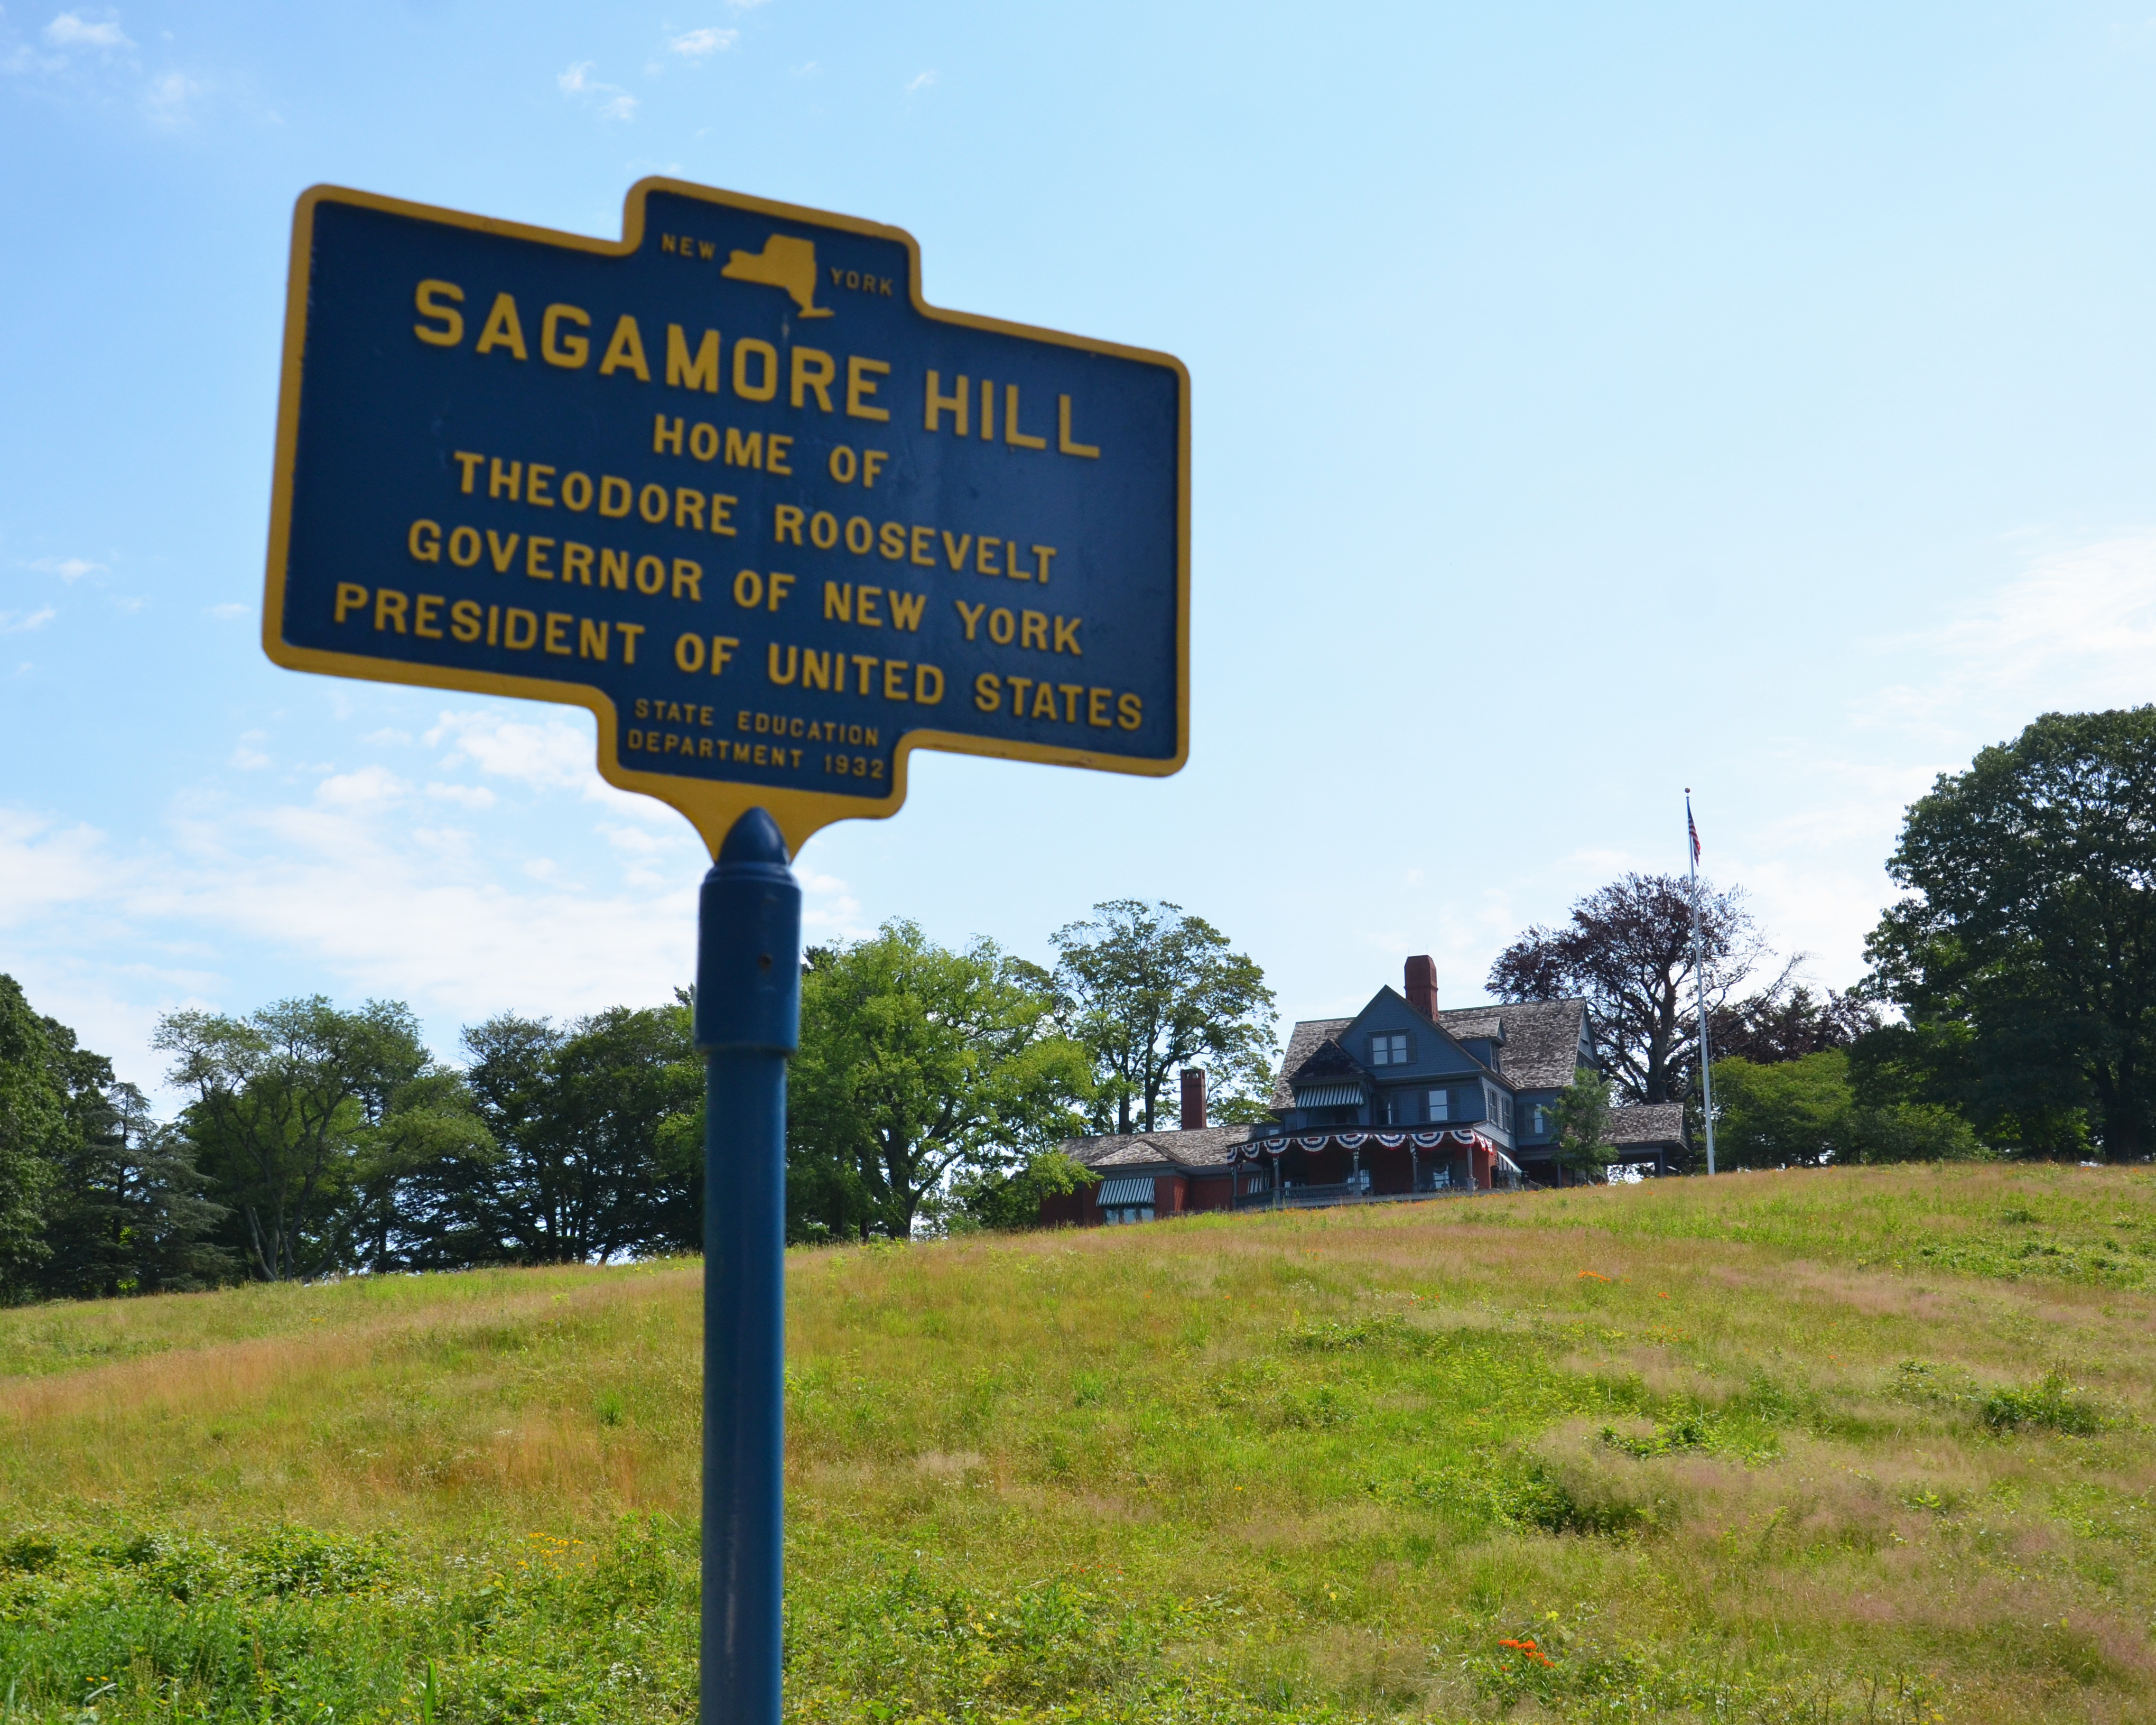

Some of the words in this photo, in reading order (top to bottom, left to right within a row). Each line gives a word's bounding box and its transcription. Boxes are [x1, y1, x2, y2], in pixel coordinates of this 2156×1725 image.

[661, 234, 714, 259] NEW
[832, 270, 891, 295] YORK
[413, 278, 891, 422] SAGAMORE
[924, 369, 1100, 459] HILL
[653, 414, 794, 476] HOME
[828, 446, 889, 488] OF
[453, 451, 738, 537] THEODORE
[774, 504, 1057, 583] ROOSEVELT
[407, 519, 703, 602] GOVERNOR
[733, 569, 796, 613] OF
[823, 581, 927, 633] NEW
[955, 600, 1082, 656] YORK
[333, 582, 646, 665] PRESIDENT
[674, 633, 740, 676] OF
[767, 644, 945, 706] UNITED
[974, 672, 1143, 731] STATES
[627, 729, 803, 768] DEPARTMENT
[825, 755, 884, 780] 1932
[635, 699, 713, 727] STATE
[737, 711, 878, 747] EDUCATION
